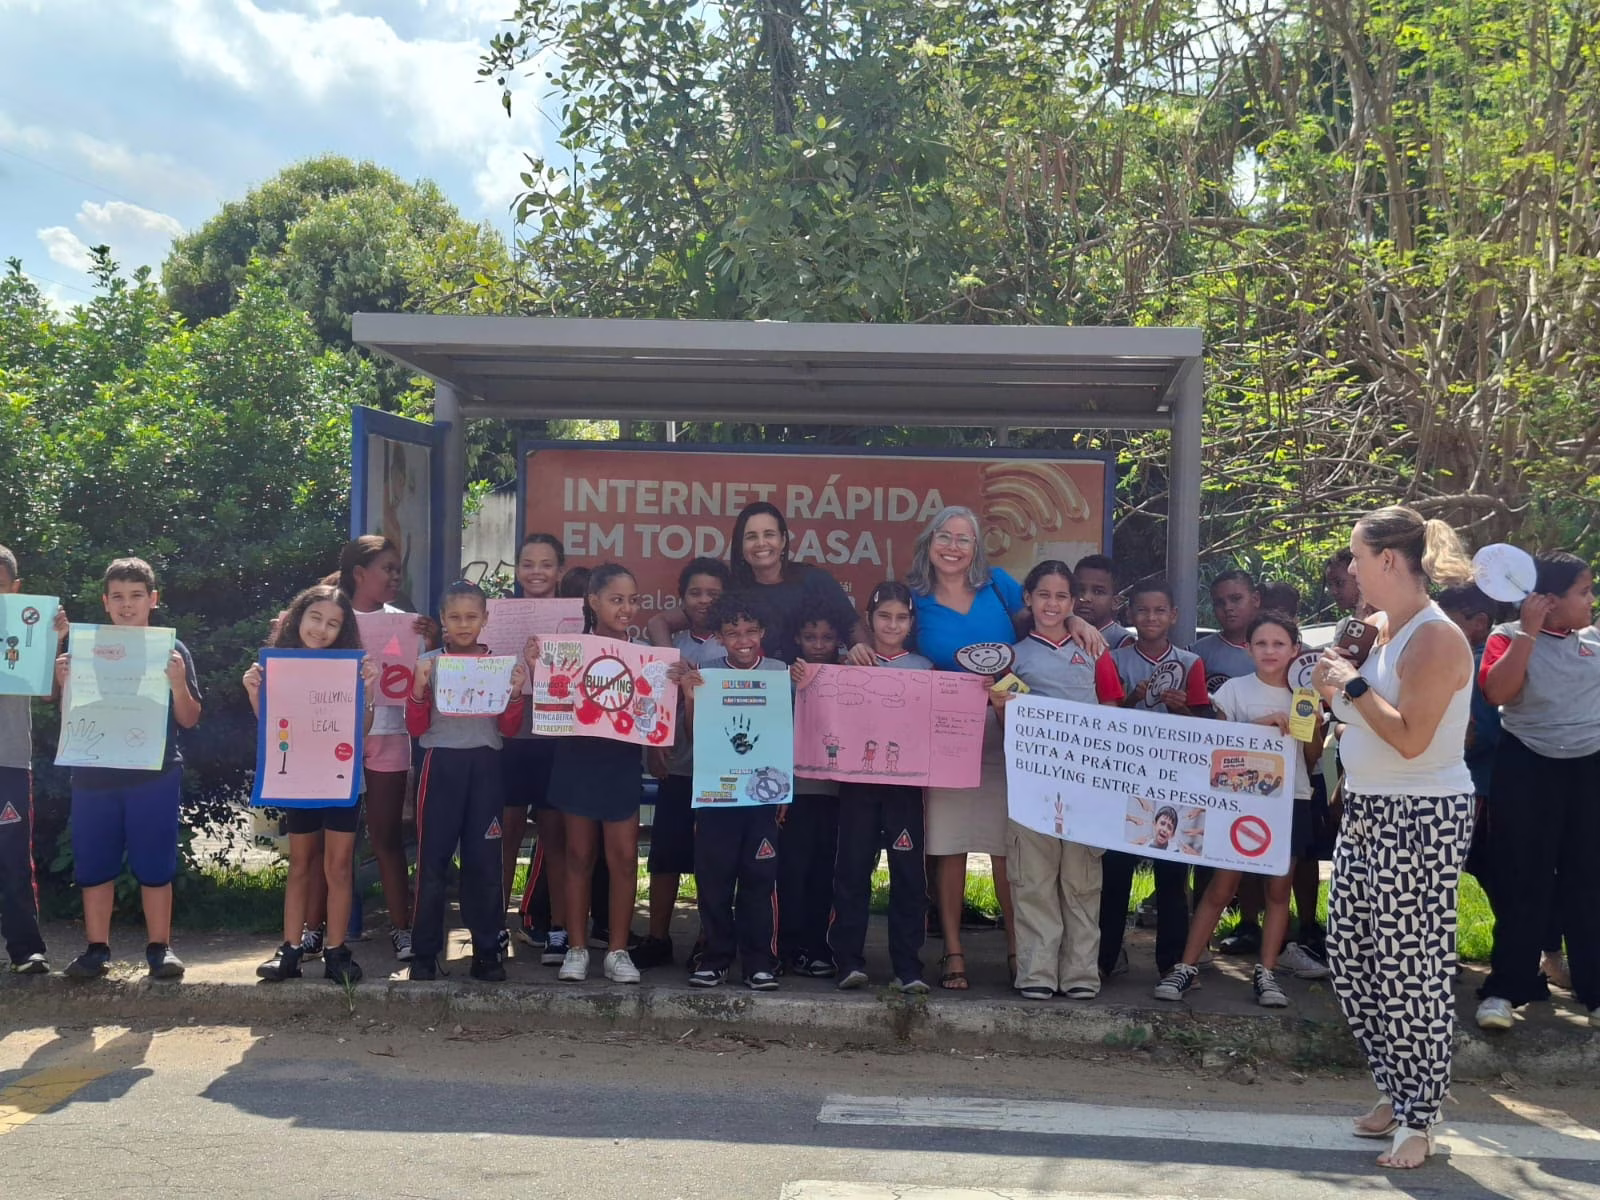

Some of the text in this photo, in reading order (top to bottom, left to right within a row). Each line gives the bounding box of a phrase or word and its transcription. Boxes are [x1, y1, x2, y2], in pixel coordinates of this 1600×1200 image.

[563, 474, 945, 522] INTERNET RÁPIDA
[563, 522, 624, 557] EM
[634, 523, 732, 560] TOD
[309, 689, 353, 705] BULLYING
[1015, 723, 1212, 768] QUALIDADES DOS OUTROS,
[1017, 705, 1284, 752] RESPEITAR AS DIVERSIDADES E AS
[1015, 740, 1178, 782] EVITA A PRÁTICA DE
[1015, 758, 1242, 812] BULLYING ENTRE AS PESSOAS.
